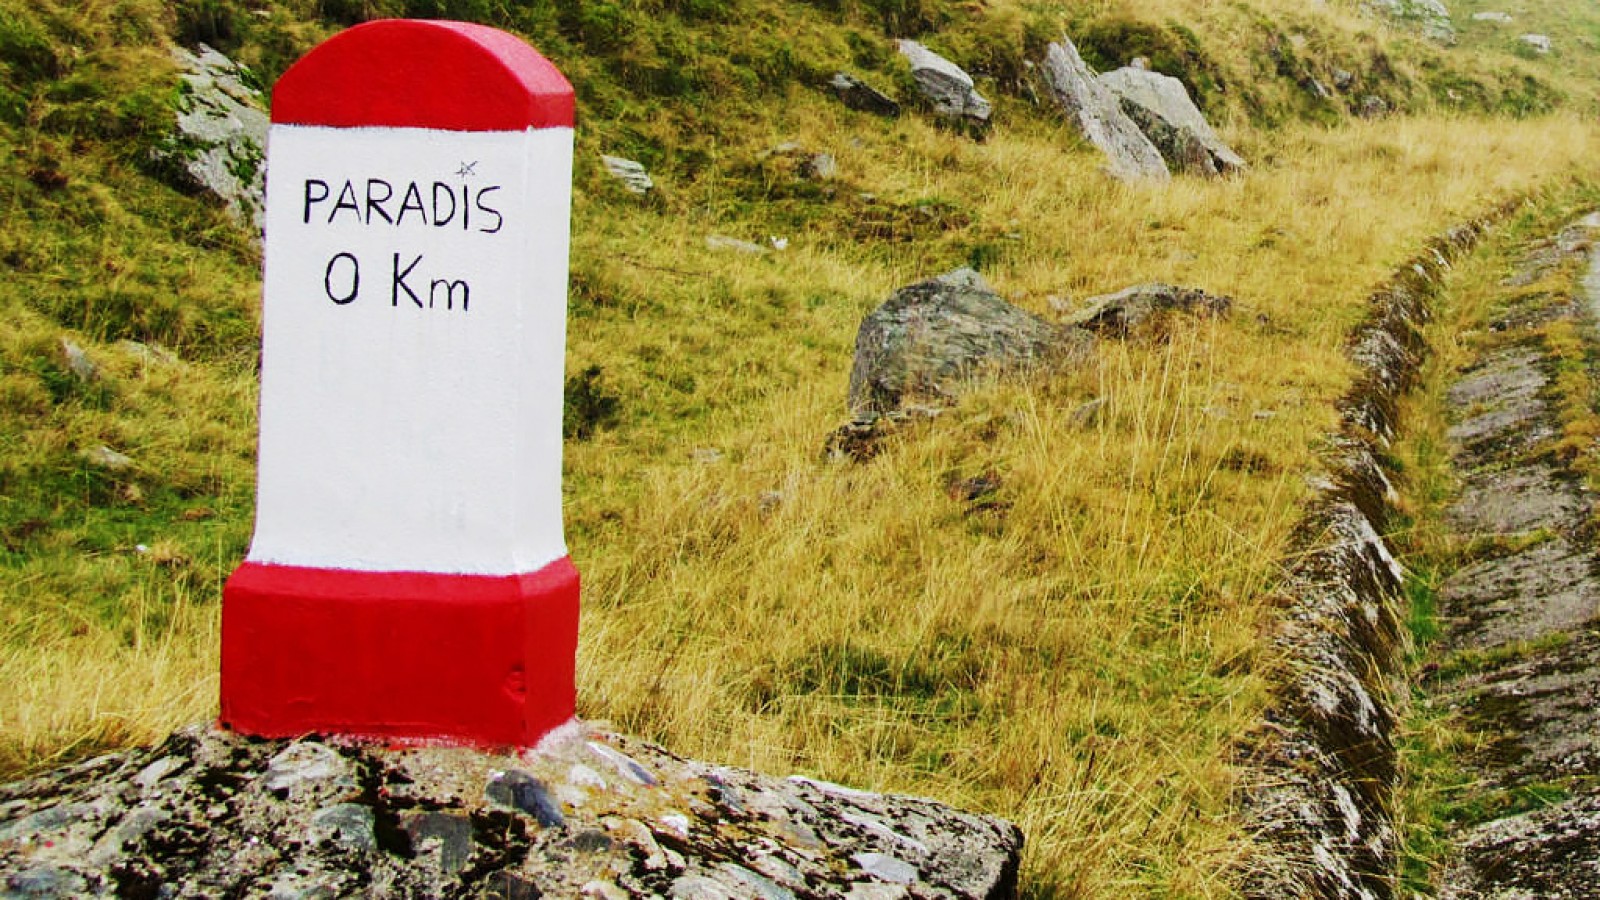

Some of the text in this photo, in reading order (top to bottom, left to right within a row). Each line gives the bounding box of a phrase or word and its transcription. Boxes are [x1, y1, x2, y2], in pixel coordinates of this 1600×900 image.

[303, 177, 503, 234] PARADIS
[324, 252, 470, 312] 0 Km
